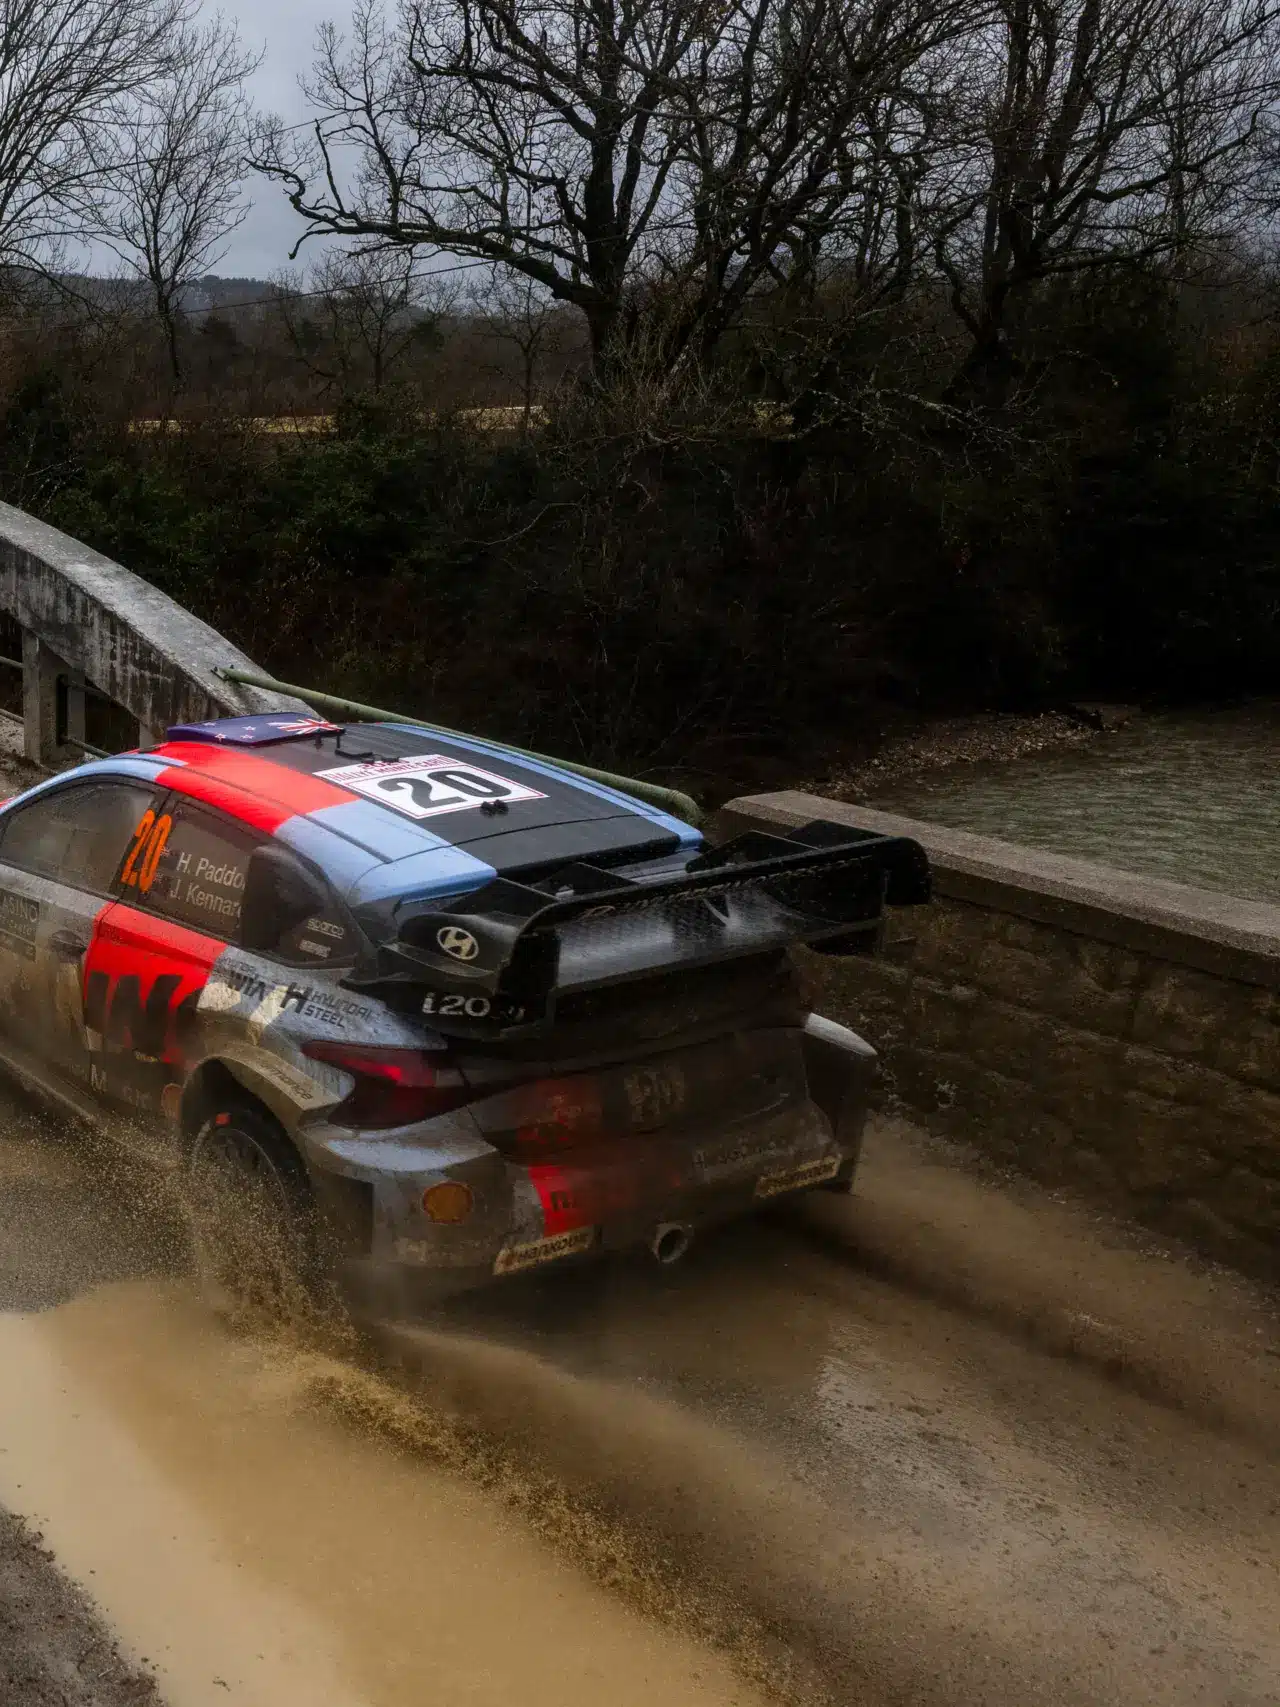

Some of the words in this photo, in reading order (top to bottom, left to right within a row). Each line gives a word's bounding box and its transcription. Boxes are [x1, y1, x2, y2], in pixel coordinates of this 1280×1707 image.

[377, 770, 512, 809] 20
[120, 808, 172, 893] 20
[176, 851, 193, 874] H.
[169, 879, 182, 900] J.
[307, 918, 345, 938] sparco
[304, 1004, 346, 1029] STEEL
[422, 992, 491, 1017] i20
